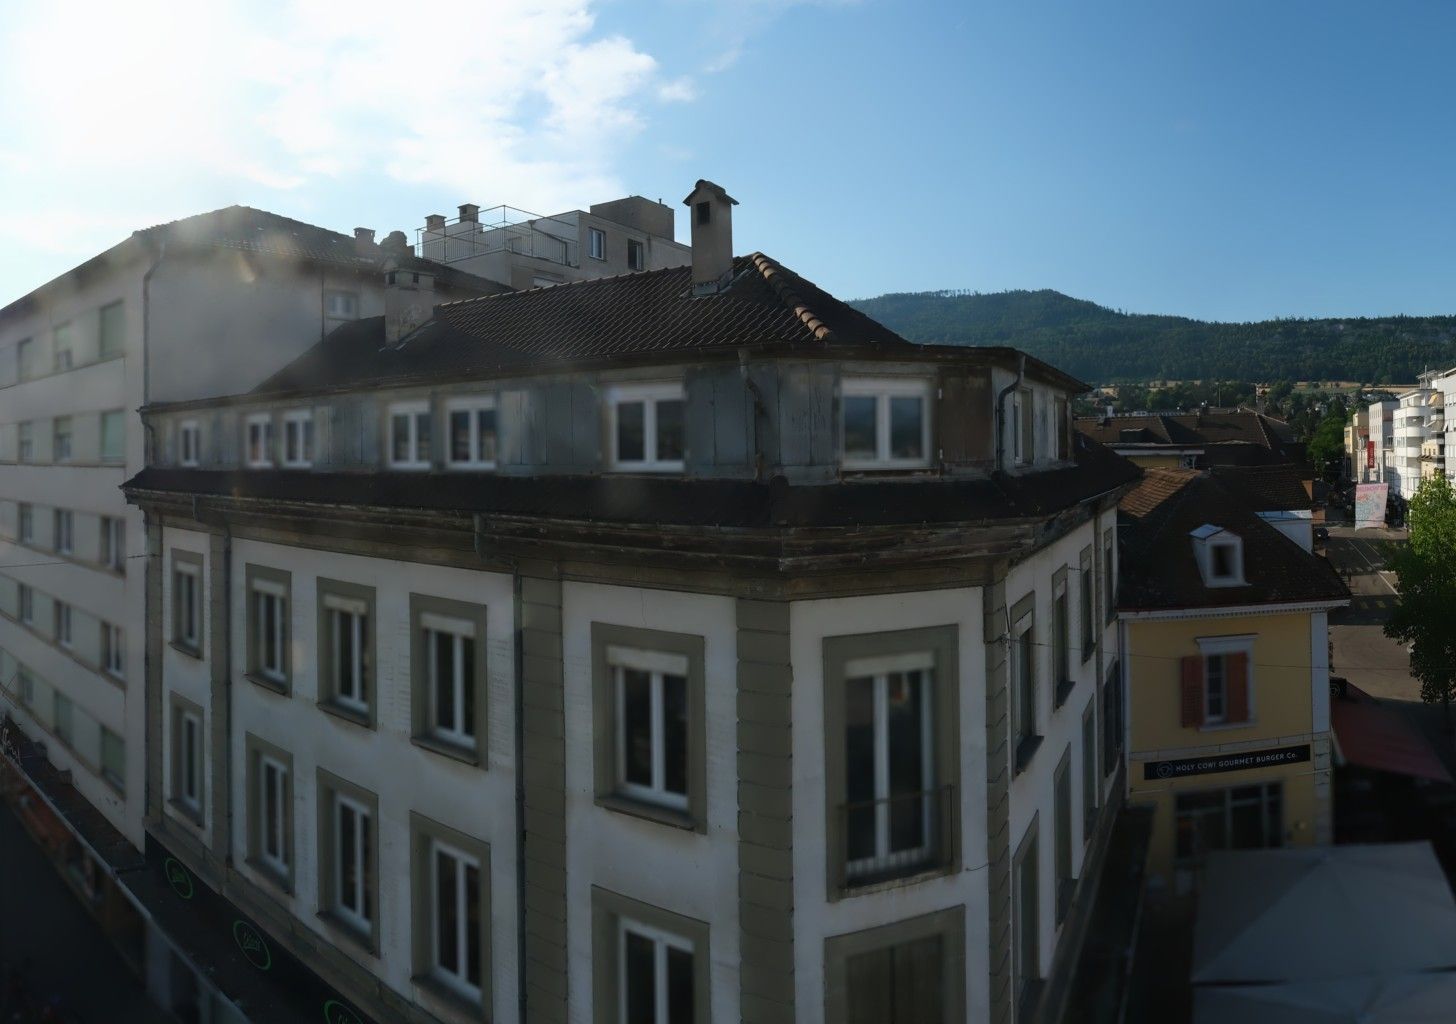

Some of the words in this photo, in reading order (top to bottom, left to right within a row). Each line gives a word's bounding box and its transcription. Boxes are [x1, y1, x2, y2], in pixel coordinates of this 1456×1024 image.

[1176, 764, 1196, 773] HOLY
[1218, 757, 1253, 768] GOURMET
[1256, 753, 1284, 763] BURGER
